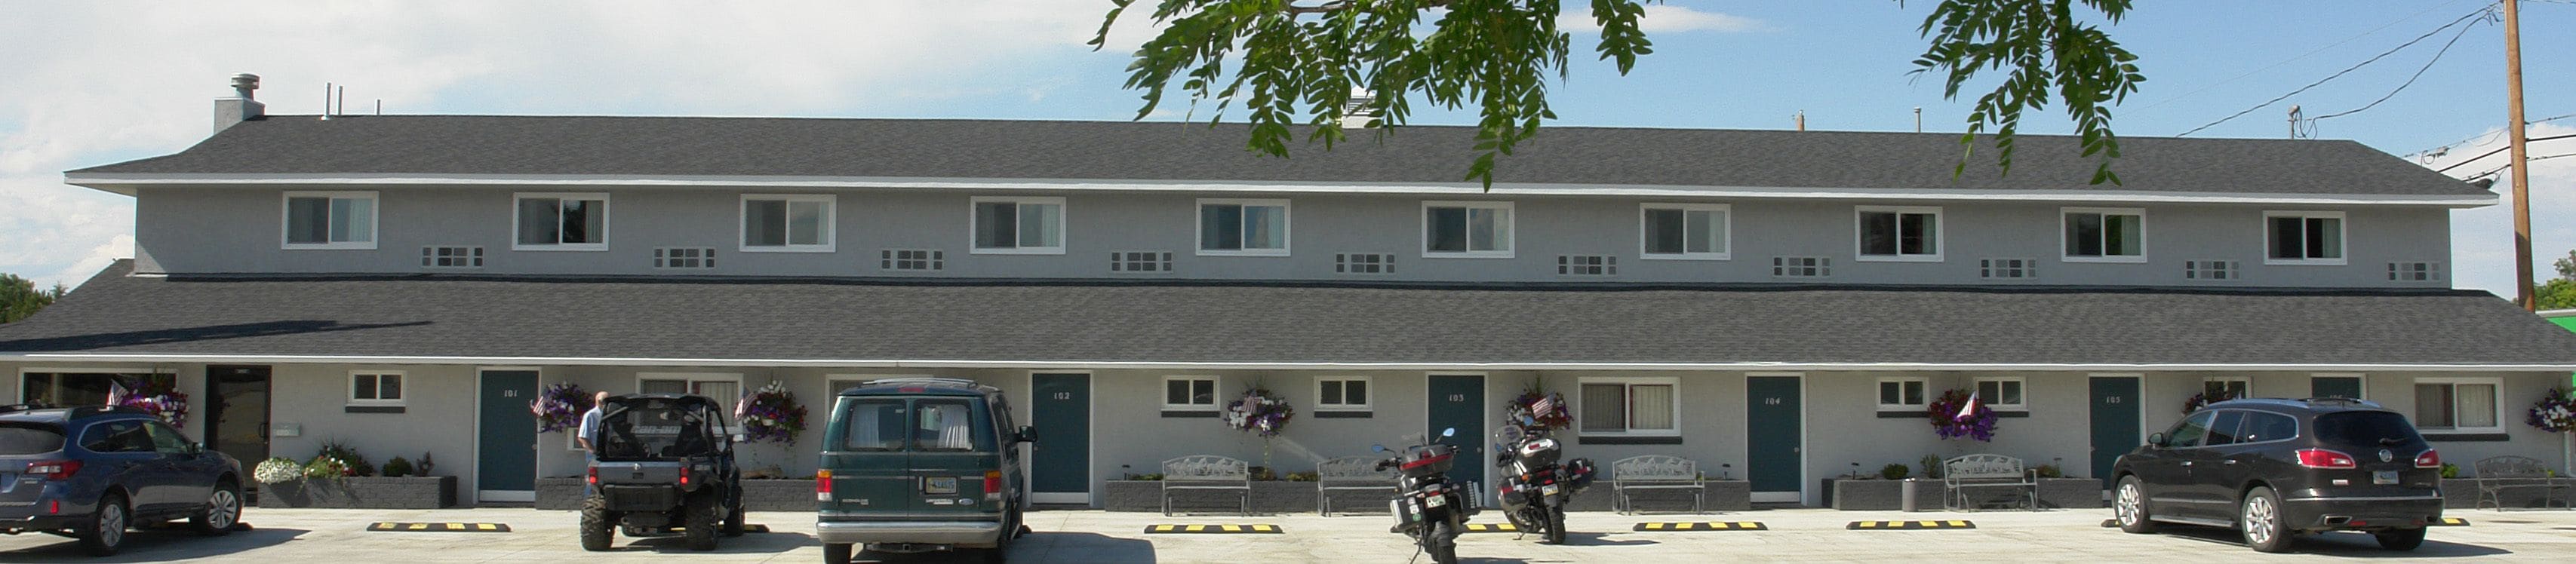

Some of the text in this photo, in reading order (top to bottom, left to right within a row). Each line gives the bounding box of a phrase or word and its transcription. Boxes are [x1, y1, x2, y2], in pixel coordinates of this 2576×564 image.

[504, 389, 518, 397] 101
[1054, 391, 1070, 400] 102
[1449, 394, 1464, 402] 103
